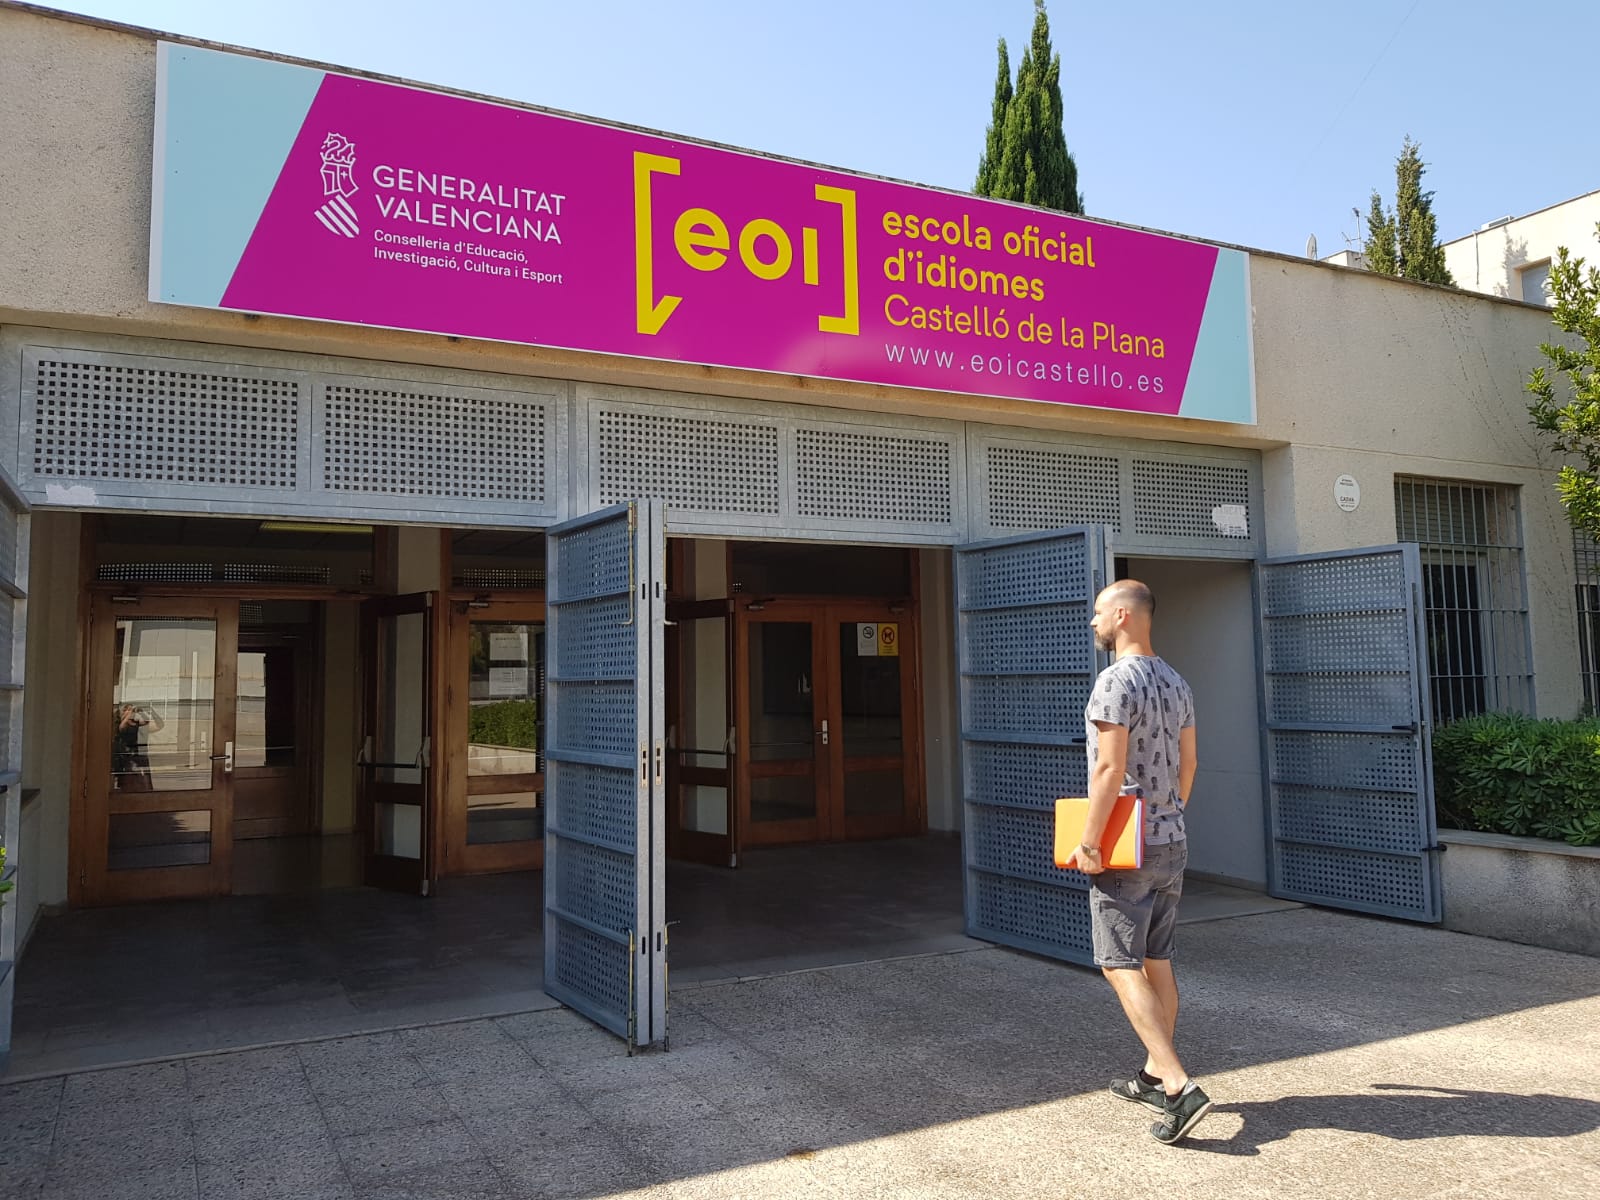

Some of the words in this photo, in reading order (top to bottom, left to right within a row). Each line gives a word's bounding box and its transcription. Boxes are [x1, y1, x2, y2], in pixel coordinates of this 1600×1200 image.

[372, 164, 566, 216] GENERALITAT
[374, 193, 562, 245] VALENCIANA
[882, 211, 993, 251] escola
[1003, 225, 1096, 268] oficial
[374, 229, 451, 252] Conselleria
[454, 240, 529, 265] d'Educació,
[374, 246, 461, 272] Investigació,
[463, 259, 512, 278] Cultura
[514, 269, 519, 278] i
[521, 267, 563, 284] Esport
[883, 248, 1045, 302] d'idiomes
[884, 294, 1010, 339] Castelló
[1017, 313, 1053, 345] de
[1061, 317, 1085, 349] la
[1093, 321, 1165, 358] Plana
[884, 343, 1164, 394] www.eoicastello.es
